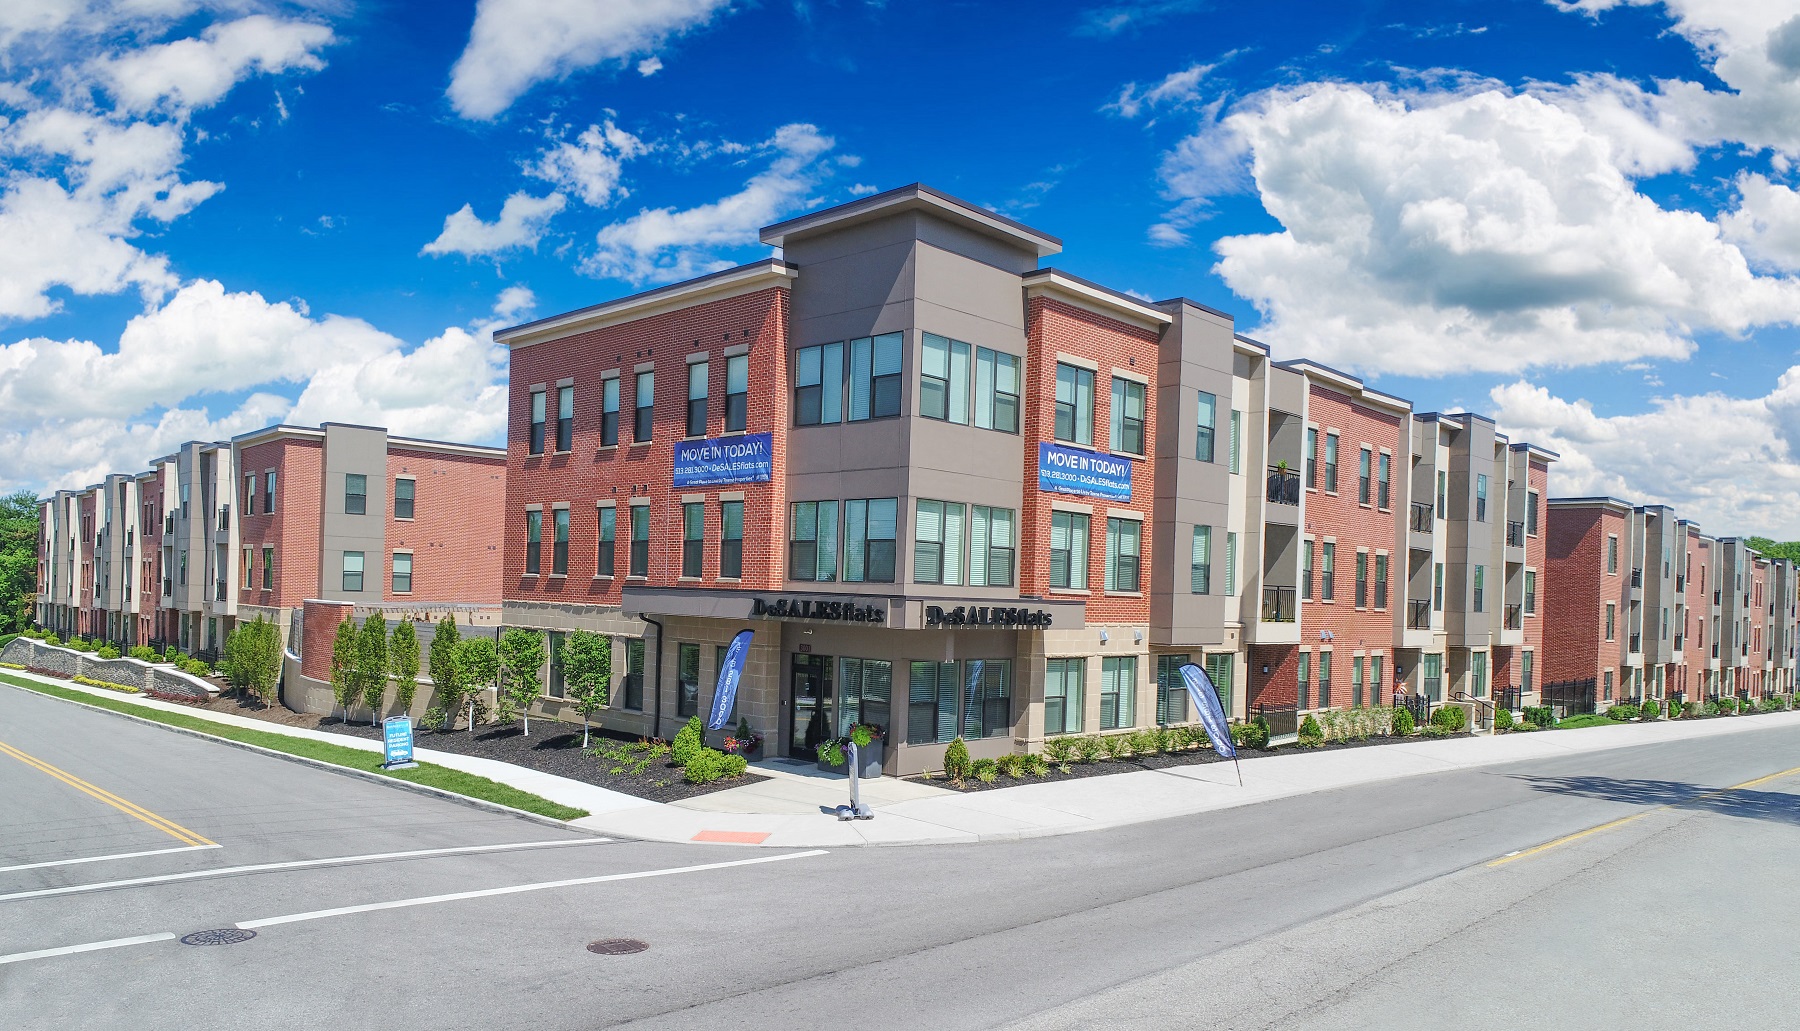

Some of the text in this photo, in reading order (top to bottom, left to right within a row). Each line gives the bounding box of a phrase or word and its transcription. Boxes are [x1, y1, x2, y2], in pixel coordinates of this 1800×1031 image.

[681, 441, 763, 462] MOVE IN TODAY!
[1047, 451, 1125, 477] MOVE IN TODAY!
